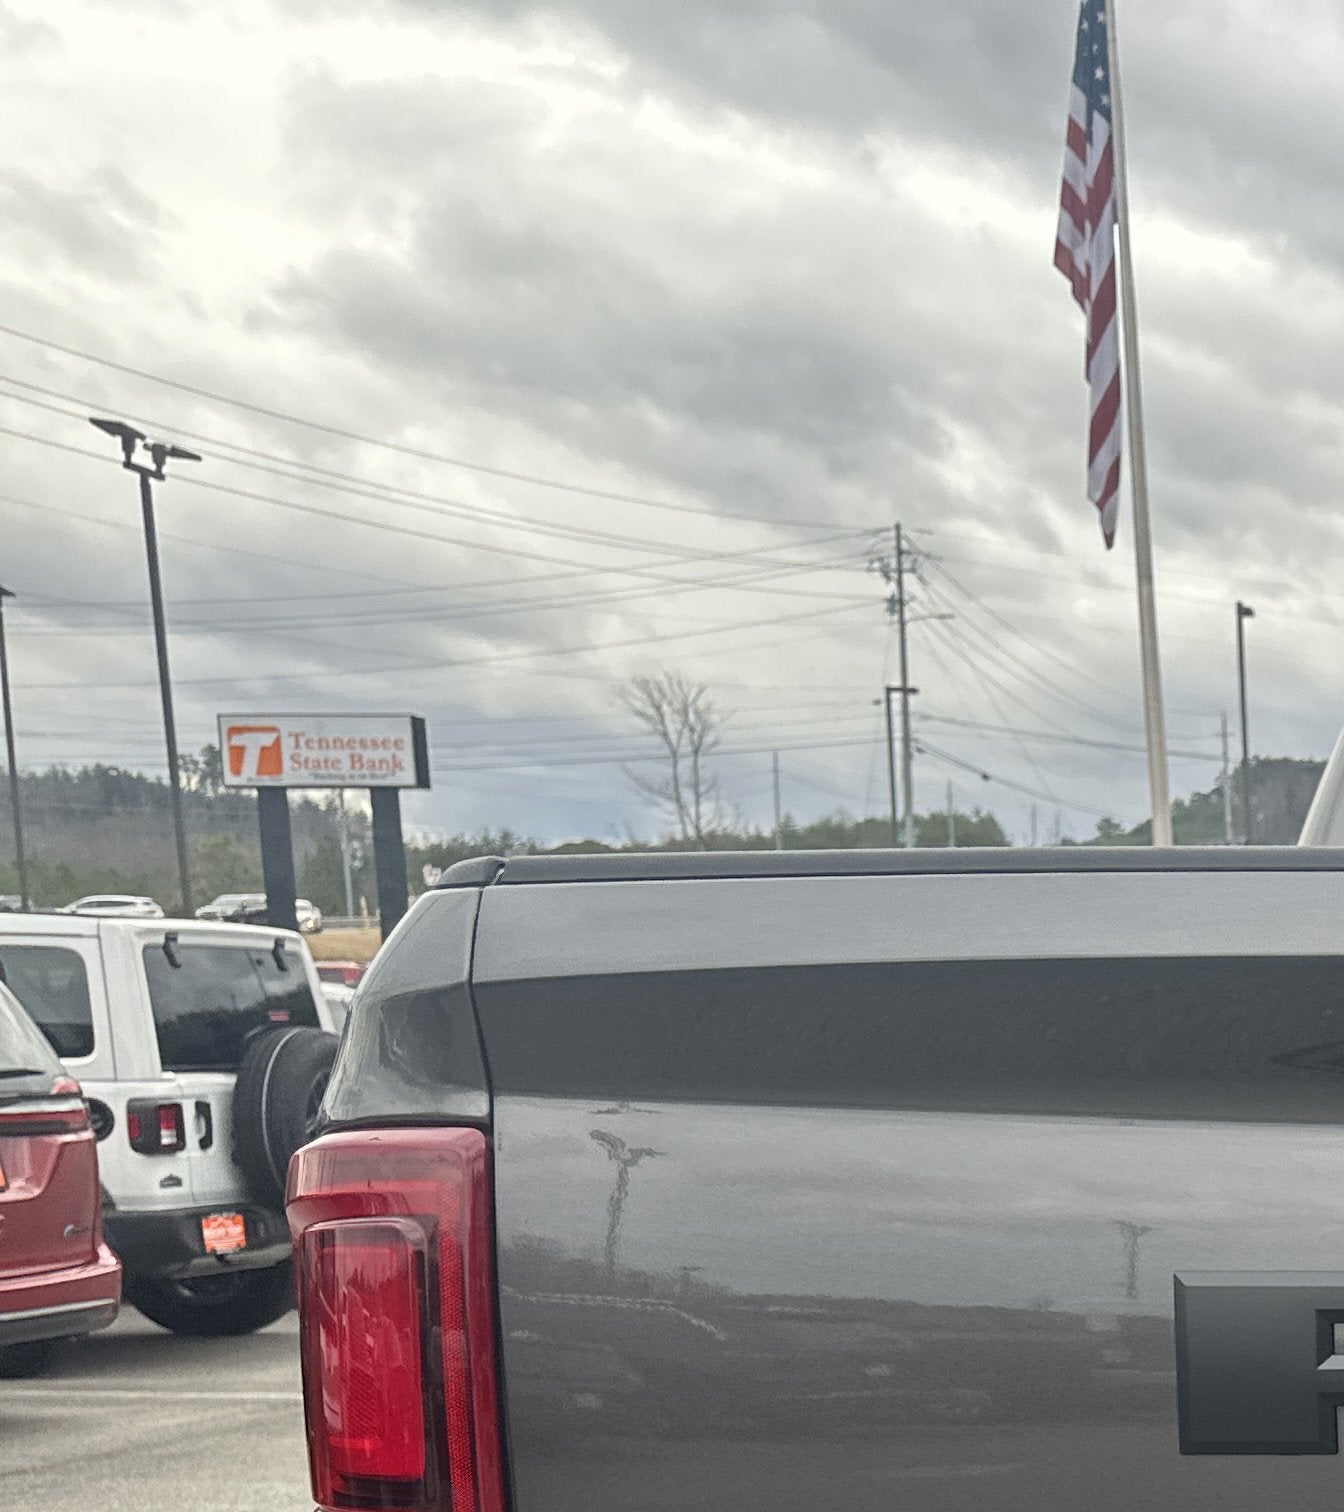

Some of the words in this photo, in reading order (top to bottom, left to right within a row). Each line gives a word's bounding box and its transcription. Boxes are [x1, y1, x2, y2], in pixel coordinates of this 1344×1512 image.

[288, 732, 405, 750] Tennessee
[289, 754, 342, 771] State
[349, 753, 404, 775] Bank
